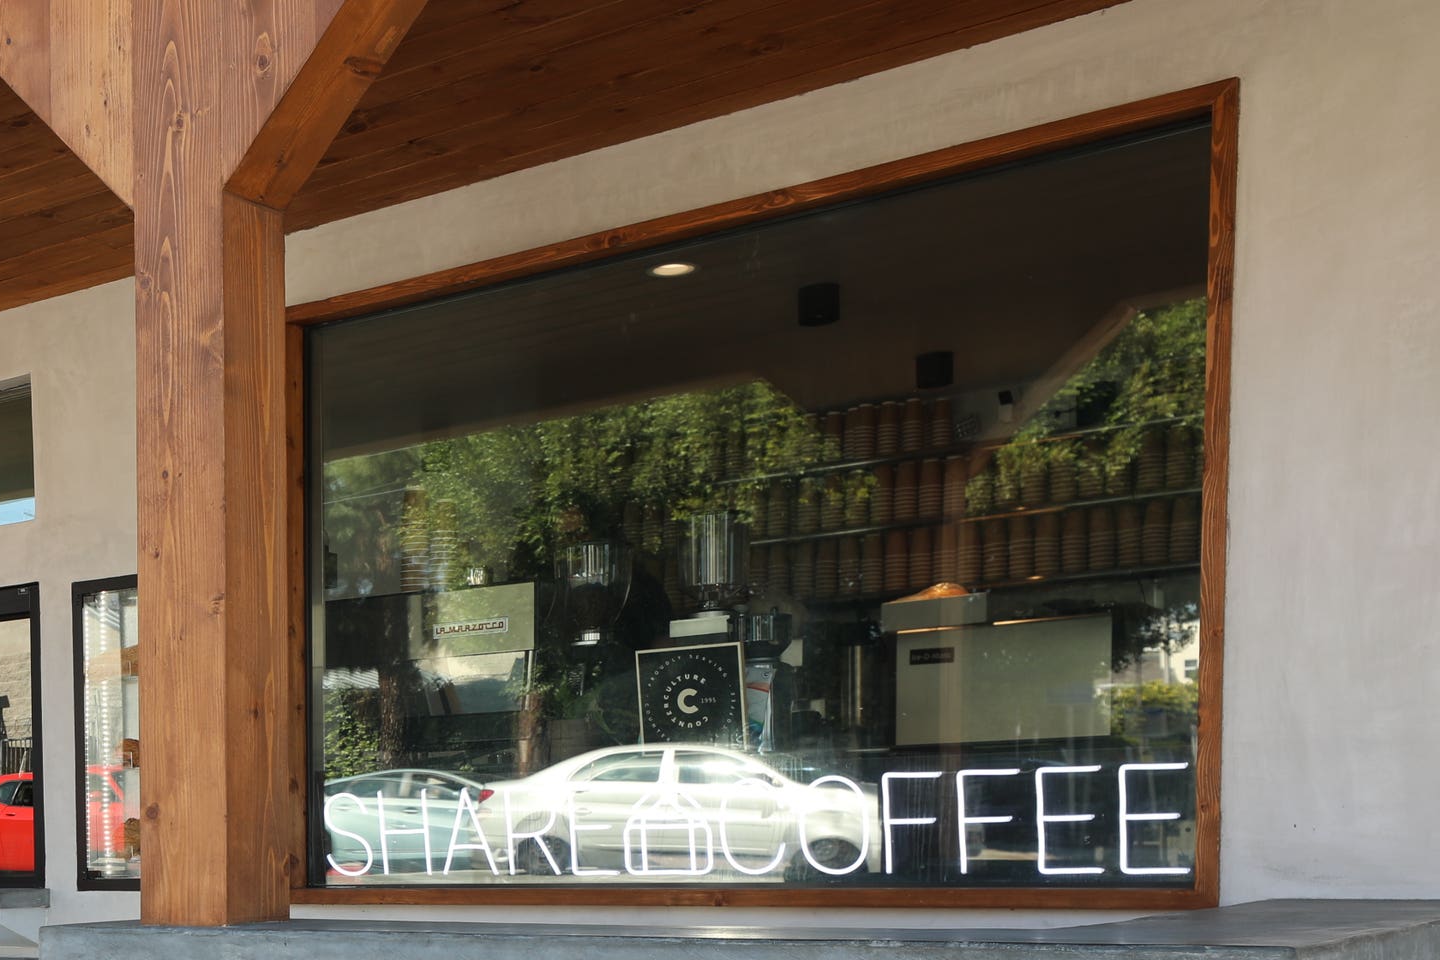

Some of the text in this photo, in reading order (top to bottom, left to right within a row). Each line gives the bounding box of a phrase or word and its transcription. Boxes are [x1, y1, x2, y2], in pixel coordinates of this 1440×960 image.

[677, 688, 699, 714] C
[323, 761, 1191, 877] SHARE COFFEE
